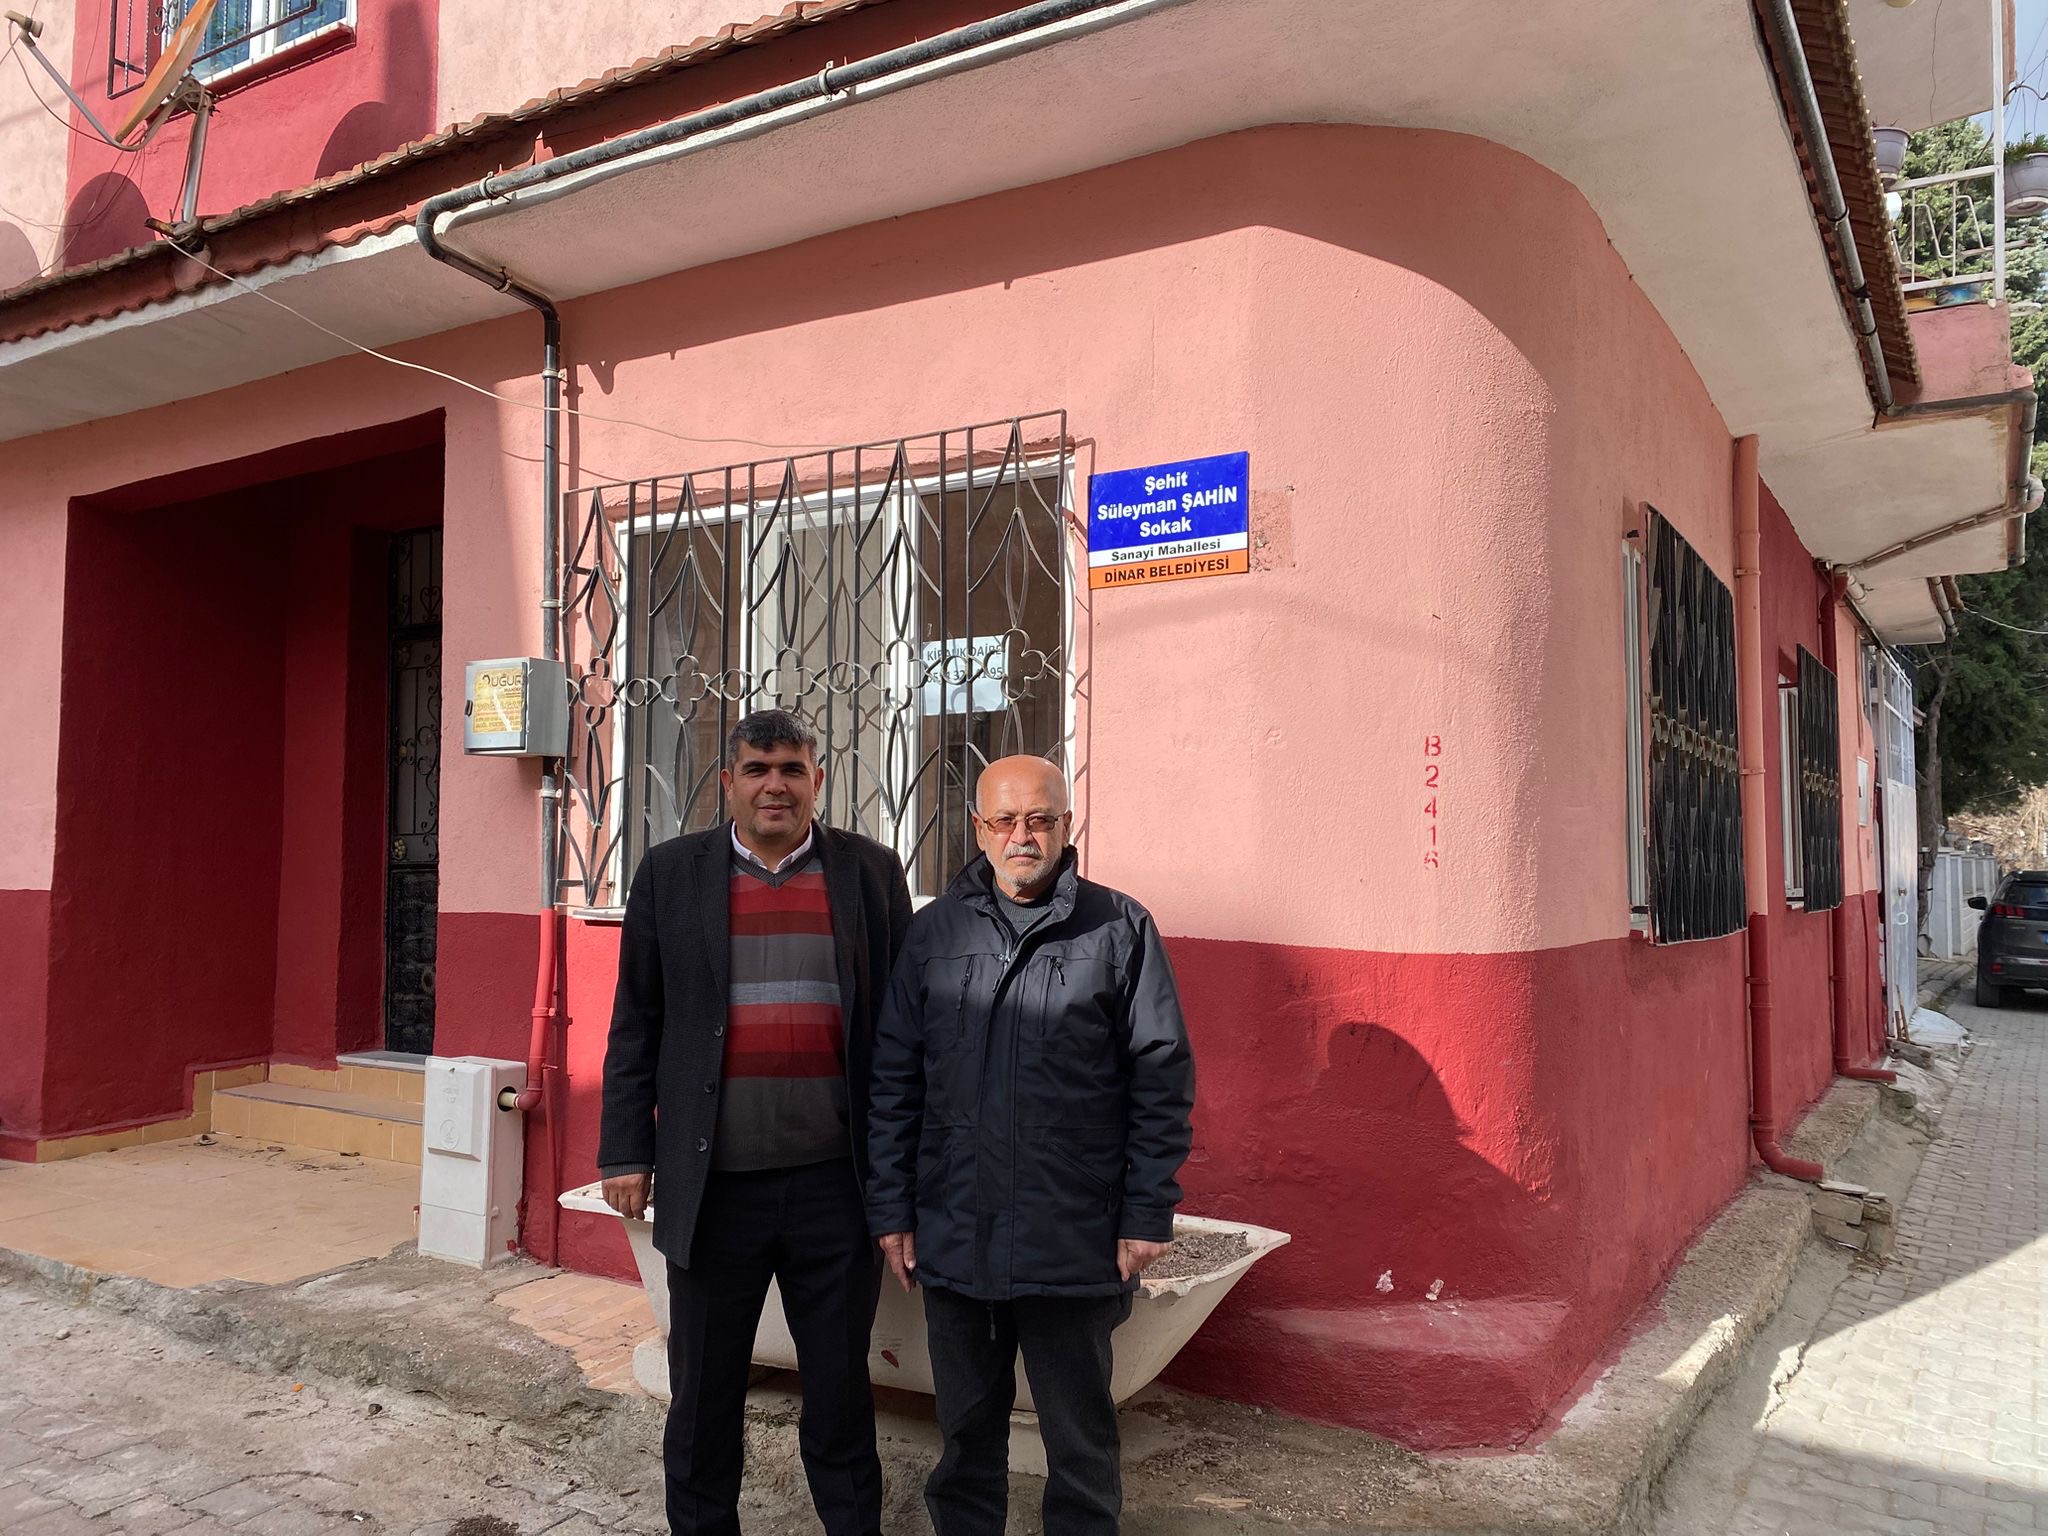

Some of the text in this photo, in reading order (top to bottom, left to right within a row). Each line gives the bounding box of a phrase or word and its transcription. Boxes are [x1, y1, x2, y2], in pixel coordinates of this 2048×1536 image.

[1145, 471, 1188, 495] Şehit
[1097, 485, 1237, 521] Süleyman ŞAHİN
[1140, 517, 1192, 537] Sokak
[1111, 539, 1221, 562] Sanayi Mahallesi
[1104, 555, 1229, 583] DİNAR BELEDİYESİ
